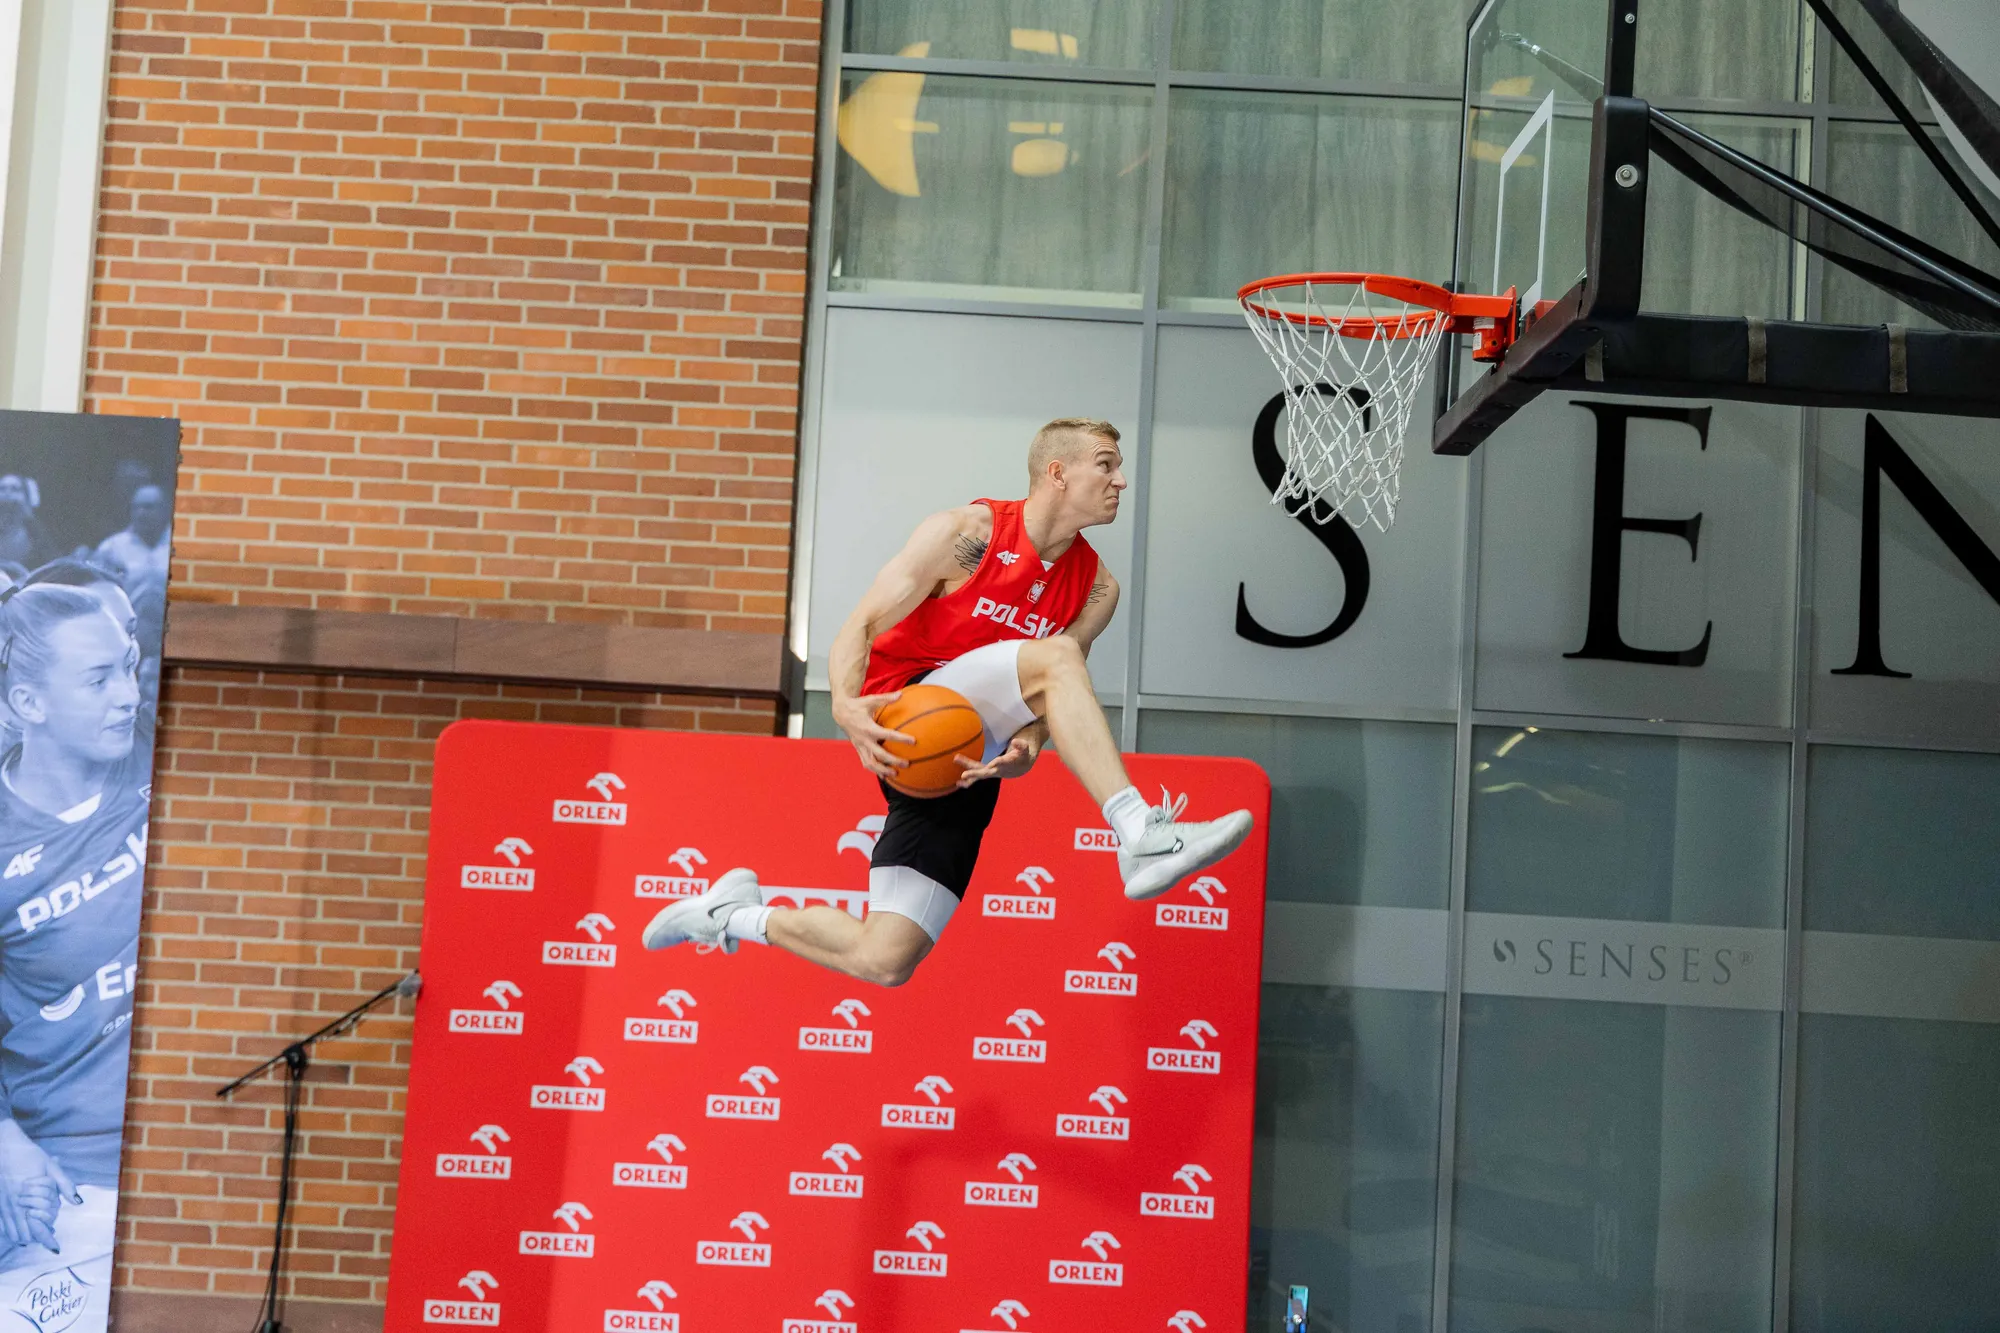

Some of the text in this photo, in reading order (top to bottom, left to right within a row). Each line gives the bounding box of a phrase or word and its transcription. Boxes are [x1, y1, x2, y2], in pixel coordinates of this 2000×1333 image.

[558, 804, 621, 821] ORLEN
[1080, 832, 1121, 848] ORL
[3, 844, 44, 879] 4F
[466, 870, 529, 887] ORLEN
[641, 880, 703, 896] ORLEN
[987, 898, 1050, 915] ORLEN
[1160, 907, 1223, 927] ORLEN
[548, 945, 611, 962] ORLEN
[1069, 974, 1132, 992] ORLEN
[454, 1013, 518, 1030] ORLEN
[629, 1022, 692, 1039] ORLEN
[804, 1031, 867, 1049] ORLEN
[978, 1041, 1041, 1059] ORLEN
[1151, 1051, 1216, 1070] ORLEN
[536, 1089, 599, 1106] ORLEN
[711, 1099, 775, 1116] ORLEN
[886, 1108, 950, 1126] ORLEN
[1061, 1118, 1125, 1137] ORLEN
[441, 1158, 506, 1175] ORLEN
[618, 1167, 682, 1184] ORLEN
[794, 1176, 858, 1194] ORLEN
[969, 1186, 1033, 1204] ORLEN
[1144, 1196, 1209, 1215] ORLEN
[524, 1235, 588, 1253] ORLEN
[701, 1245, 766, 1263] ORLEN
[878, 1254, 942, 1273] ORLEN
[1053, 1264, 1118, 1282] ORLEN
[27, 1280, 72, 1310] Polski
[429, 1304, 495, 1322] ORLEN
[609, 1314, 673, 1332] ORLEN
